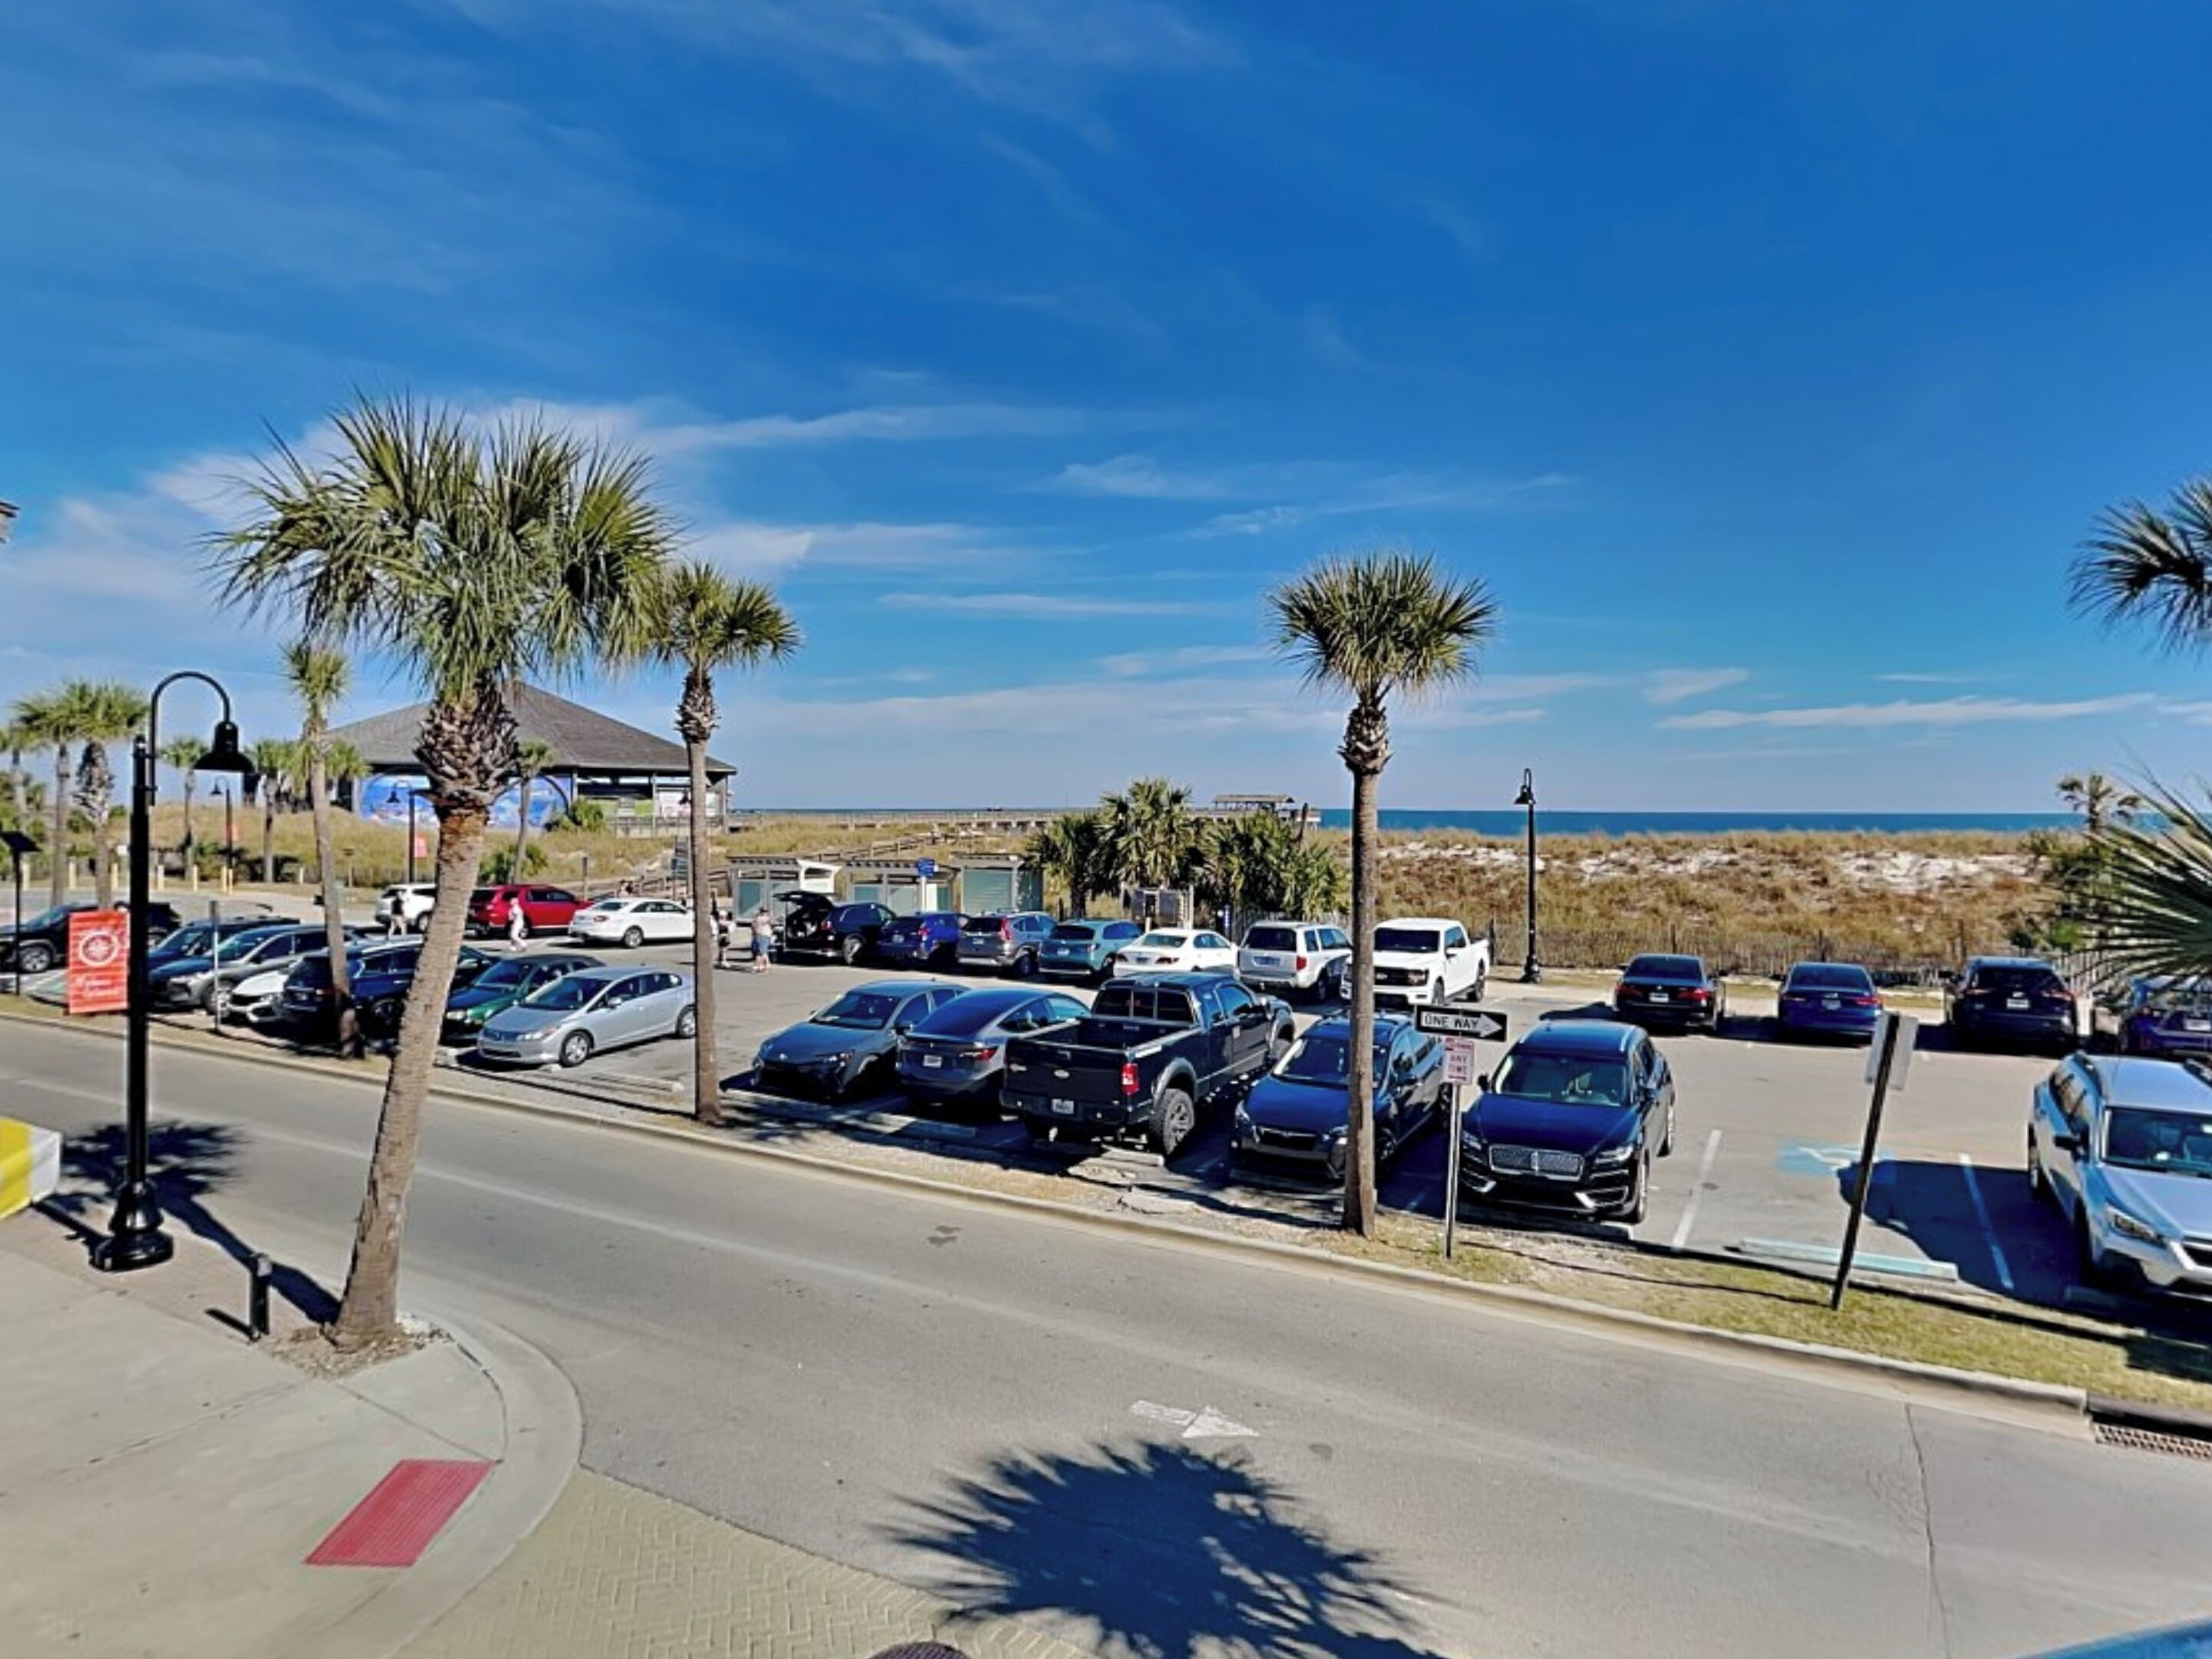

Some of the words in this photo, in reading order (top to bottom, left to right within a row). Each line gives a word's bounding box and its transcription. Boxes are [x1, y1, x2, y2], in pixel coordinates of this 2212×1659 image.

[1425, 1015, 1449, 1026] ONE
[1454, 1018, 1479, 1029] WAY
[1449, 1055, 1467, 1063] ANY
